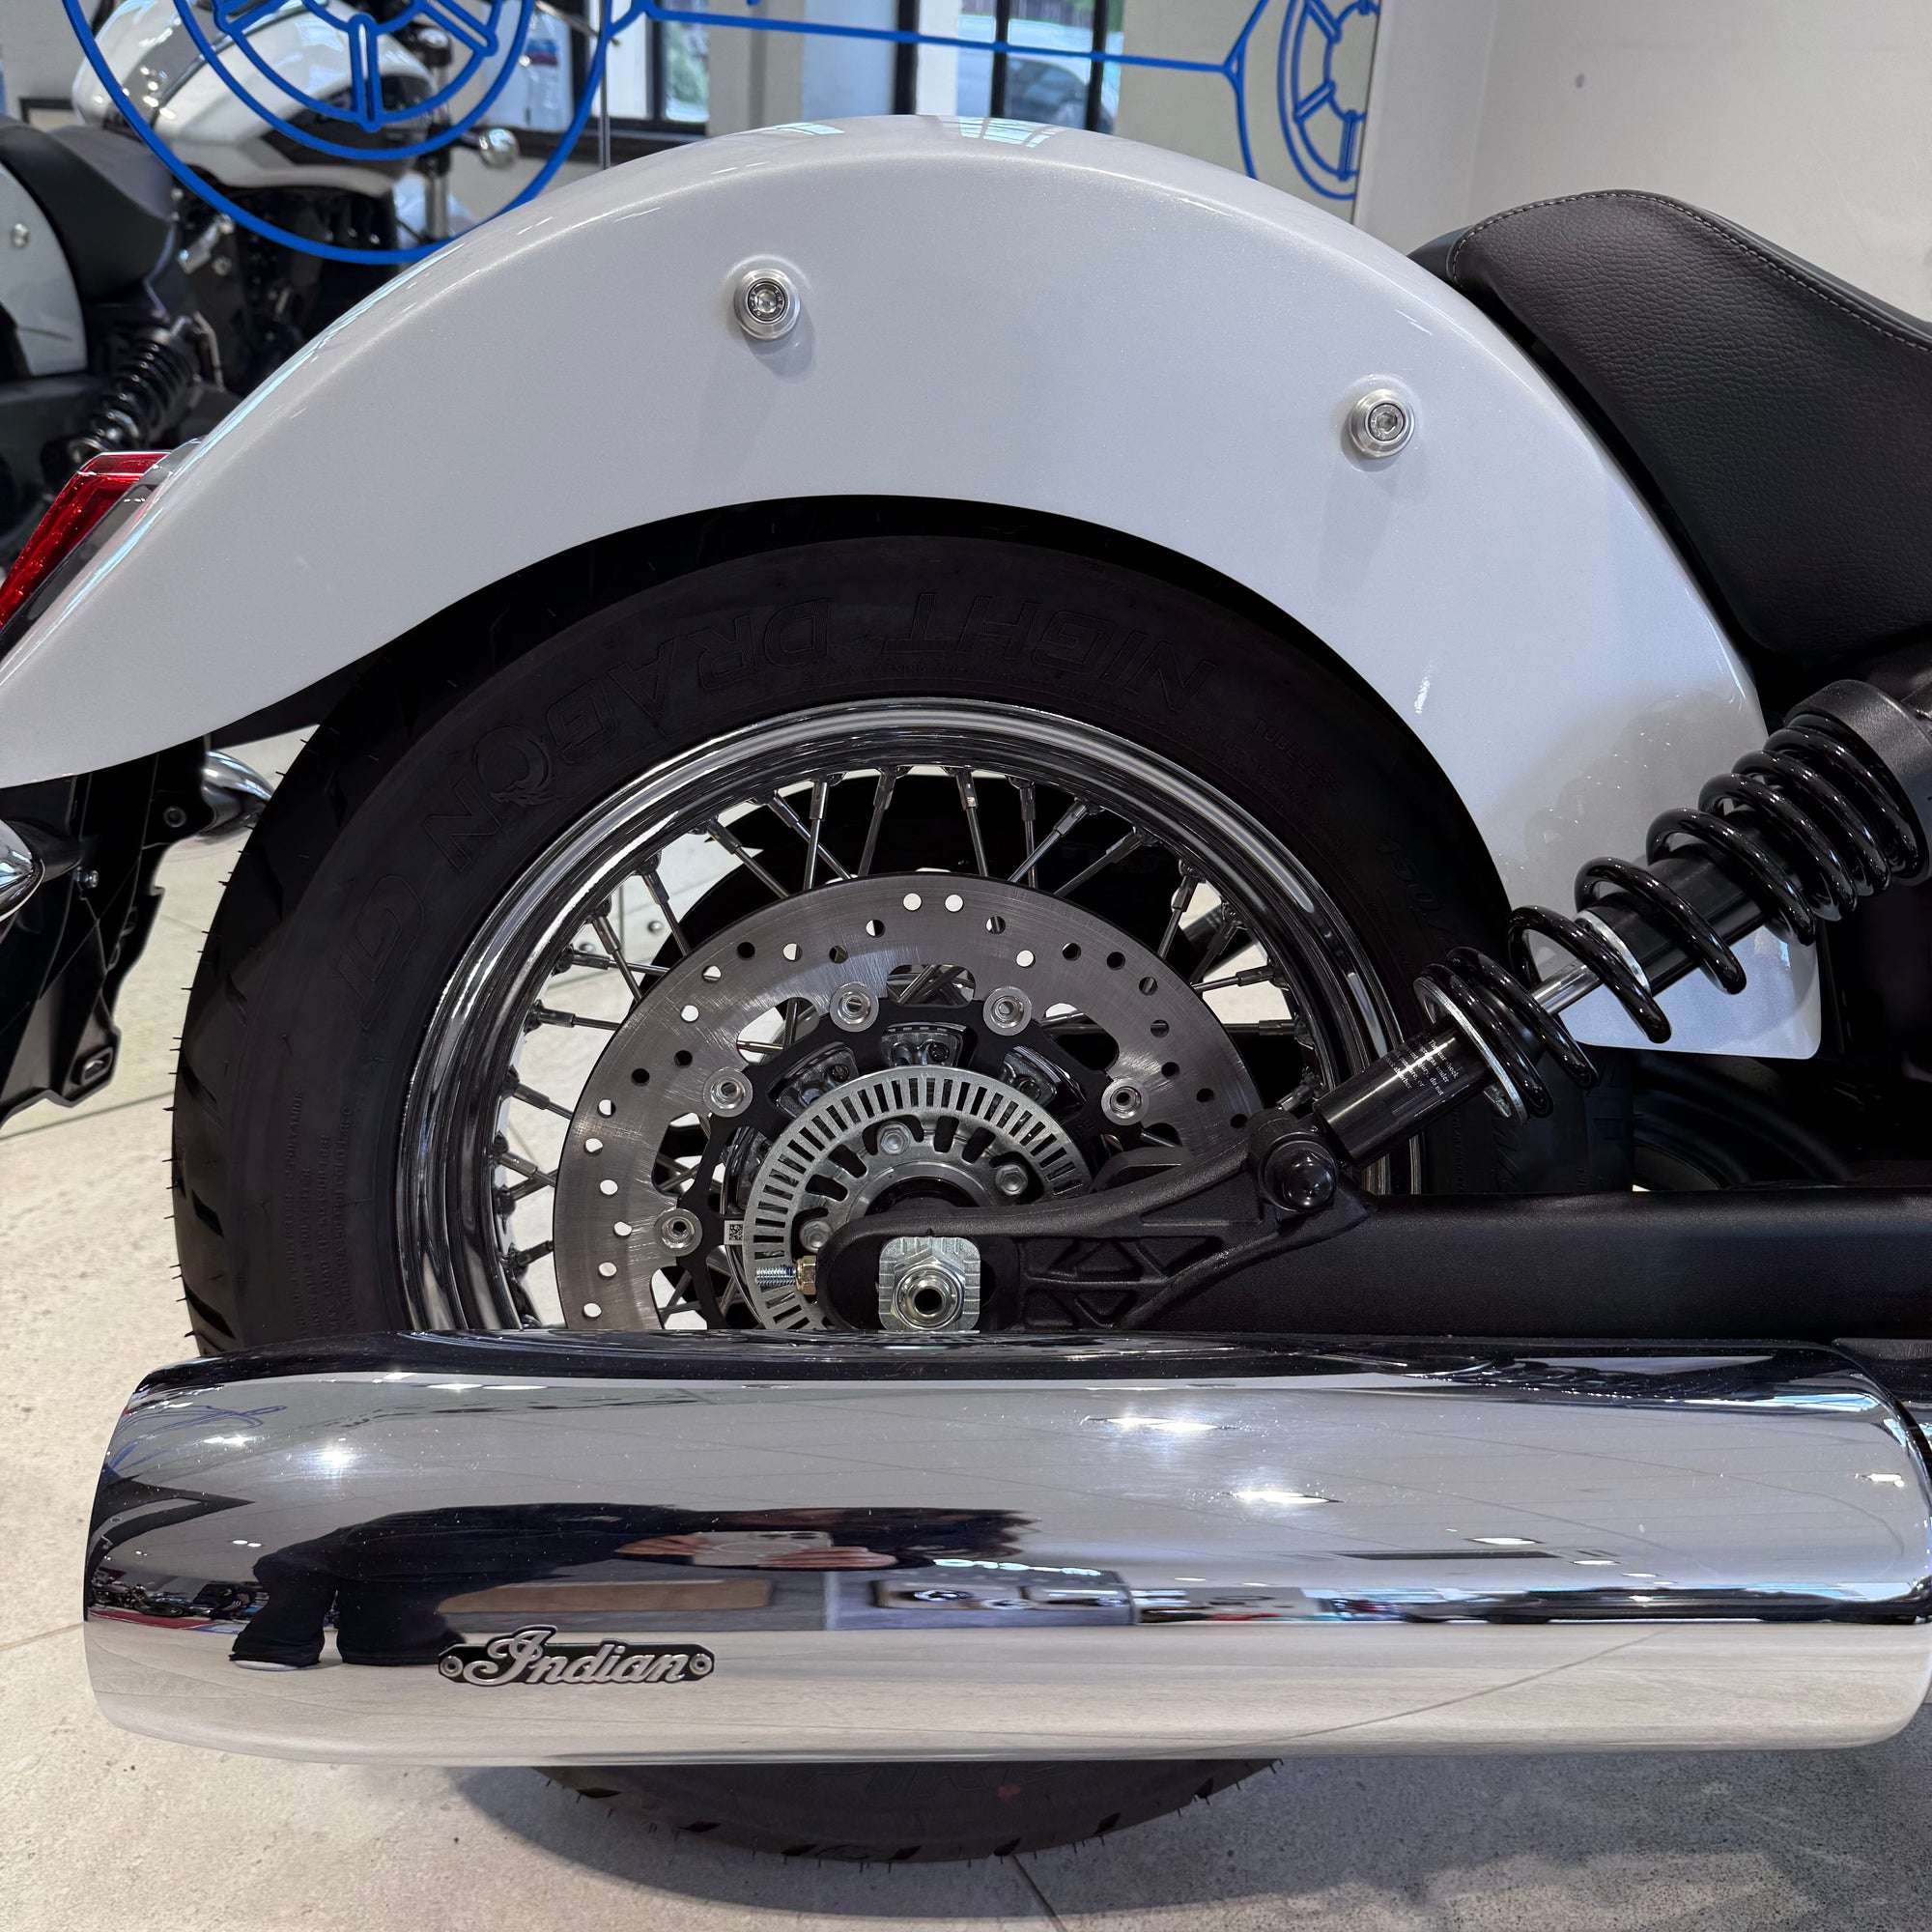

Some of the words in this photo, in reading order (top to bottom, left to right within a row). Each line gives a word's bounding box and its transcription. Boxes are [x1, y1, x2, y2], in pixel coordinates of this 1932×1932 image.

[884, 593, 1218, 713] NIGHT
[419, 596, 831, 872] DRAGON
[1435, 1065, 1450, 1083] under
[463, 1630, 690, 1687] Indian
